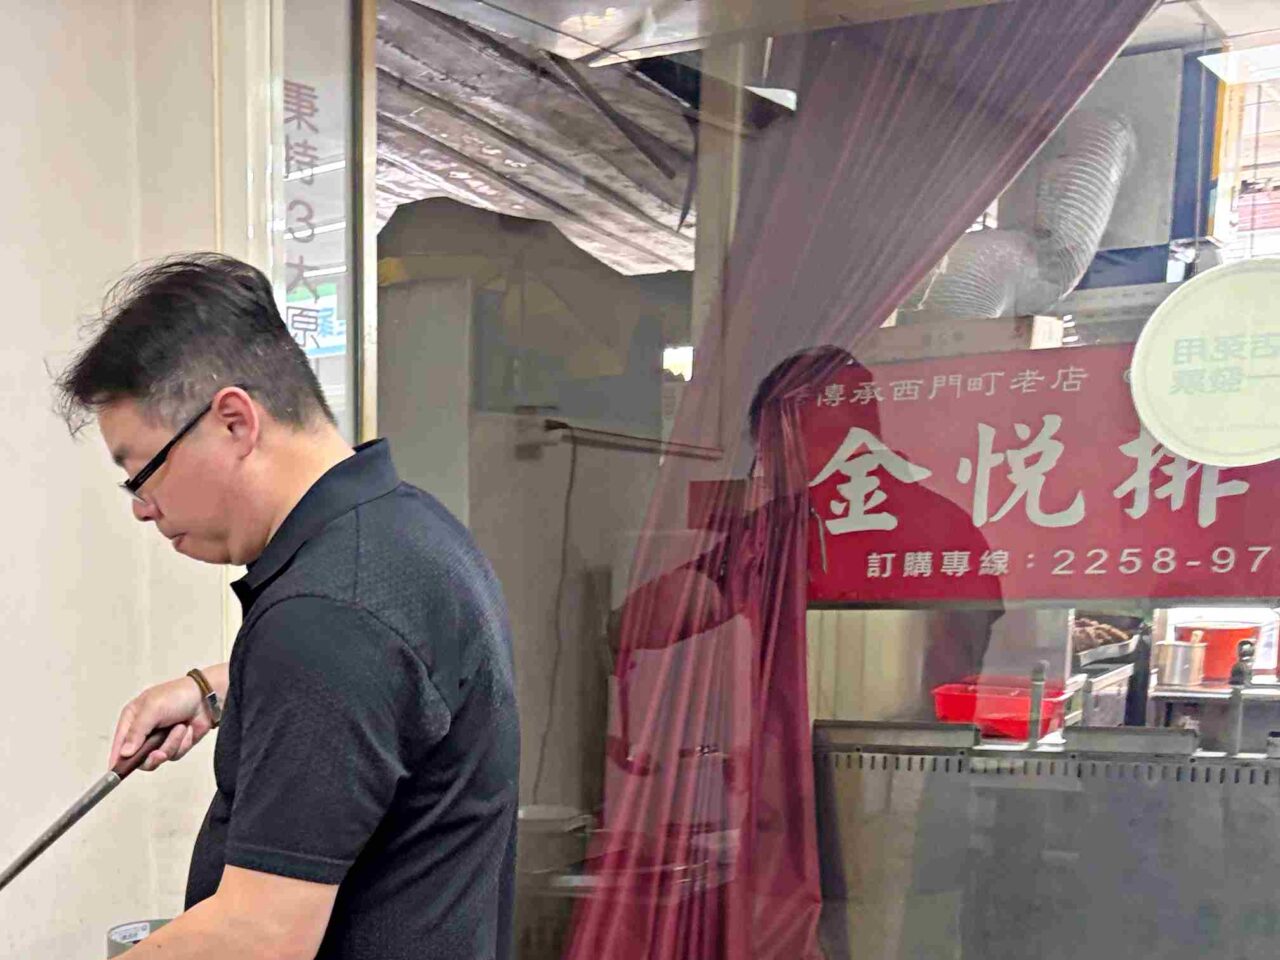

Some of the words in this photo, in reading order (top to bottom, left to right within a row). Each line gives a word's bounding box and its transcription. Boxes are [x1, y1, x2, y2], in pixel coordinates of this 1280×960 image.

[816, 366, 1088, 408] 傳承西門町老店
